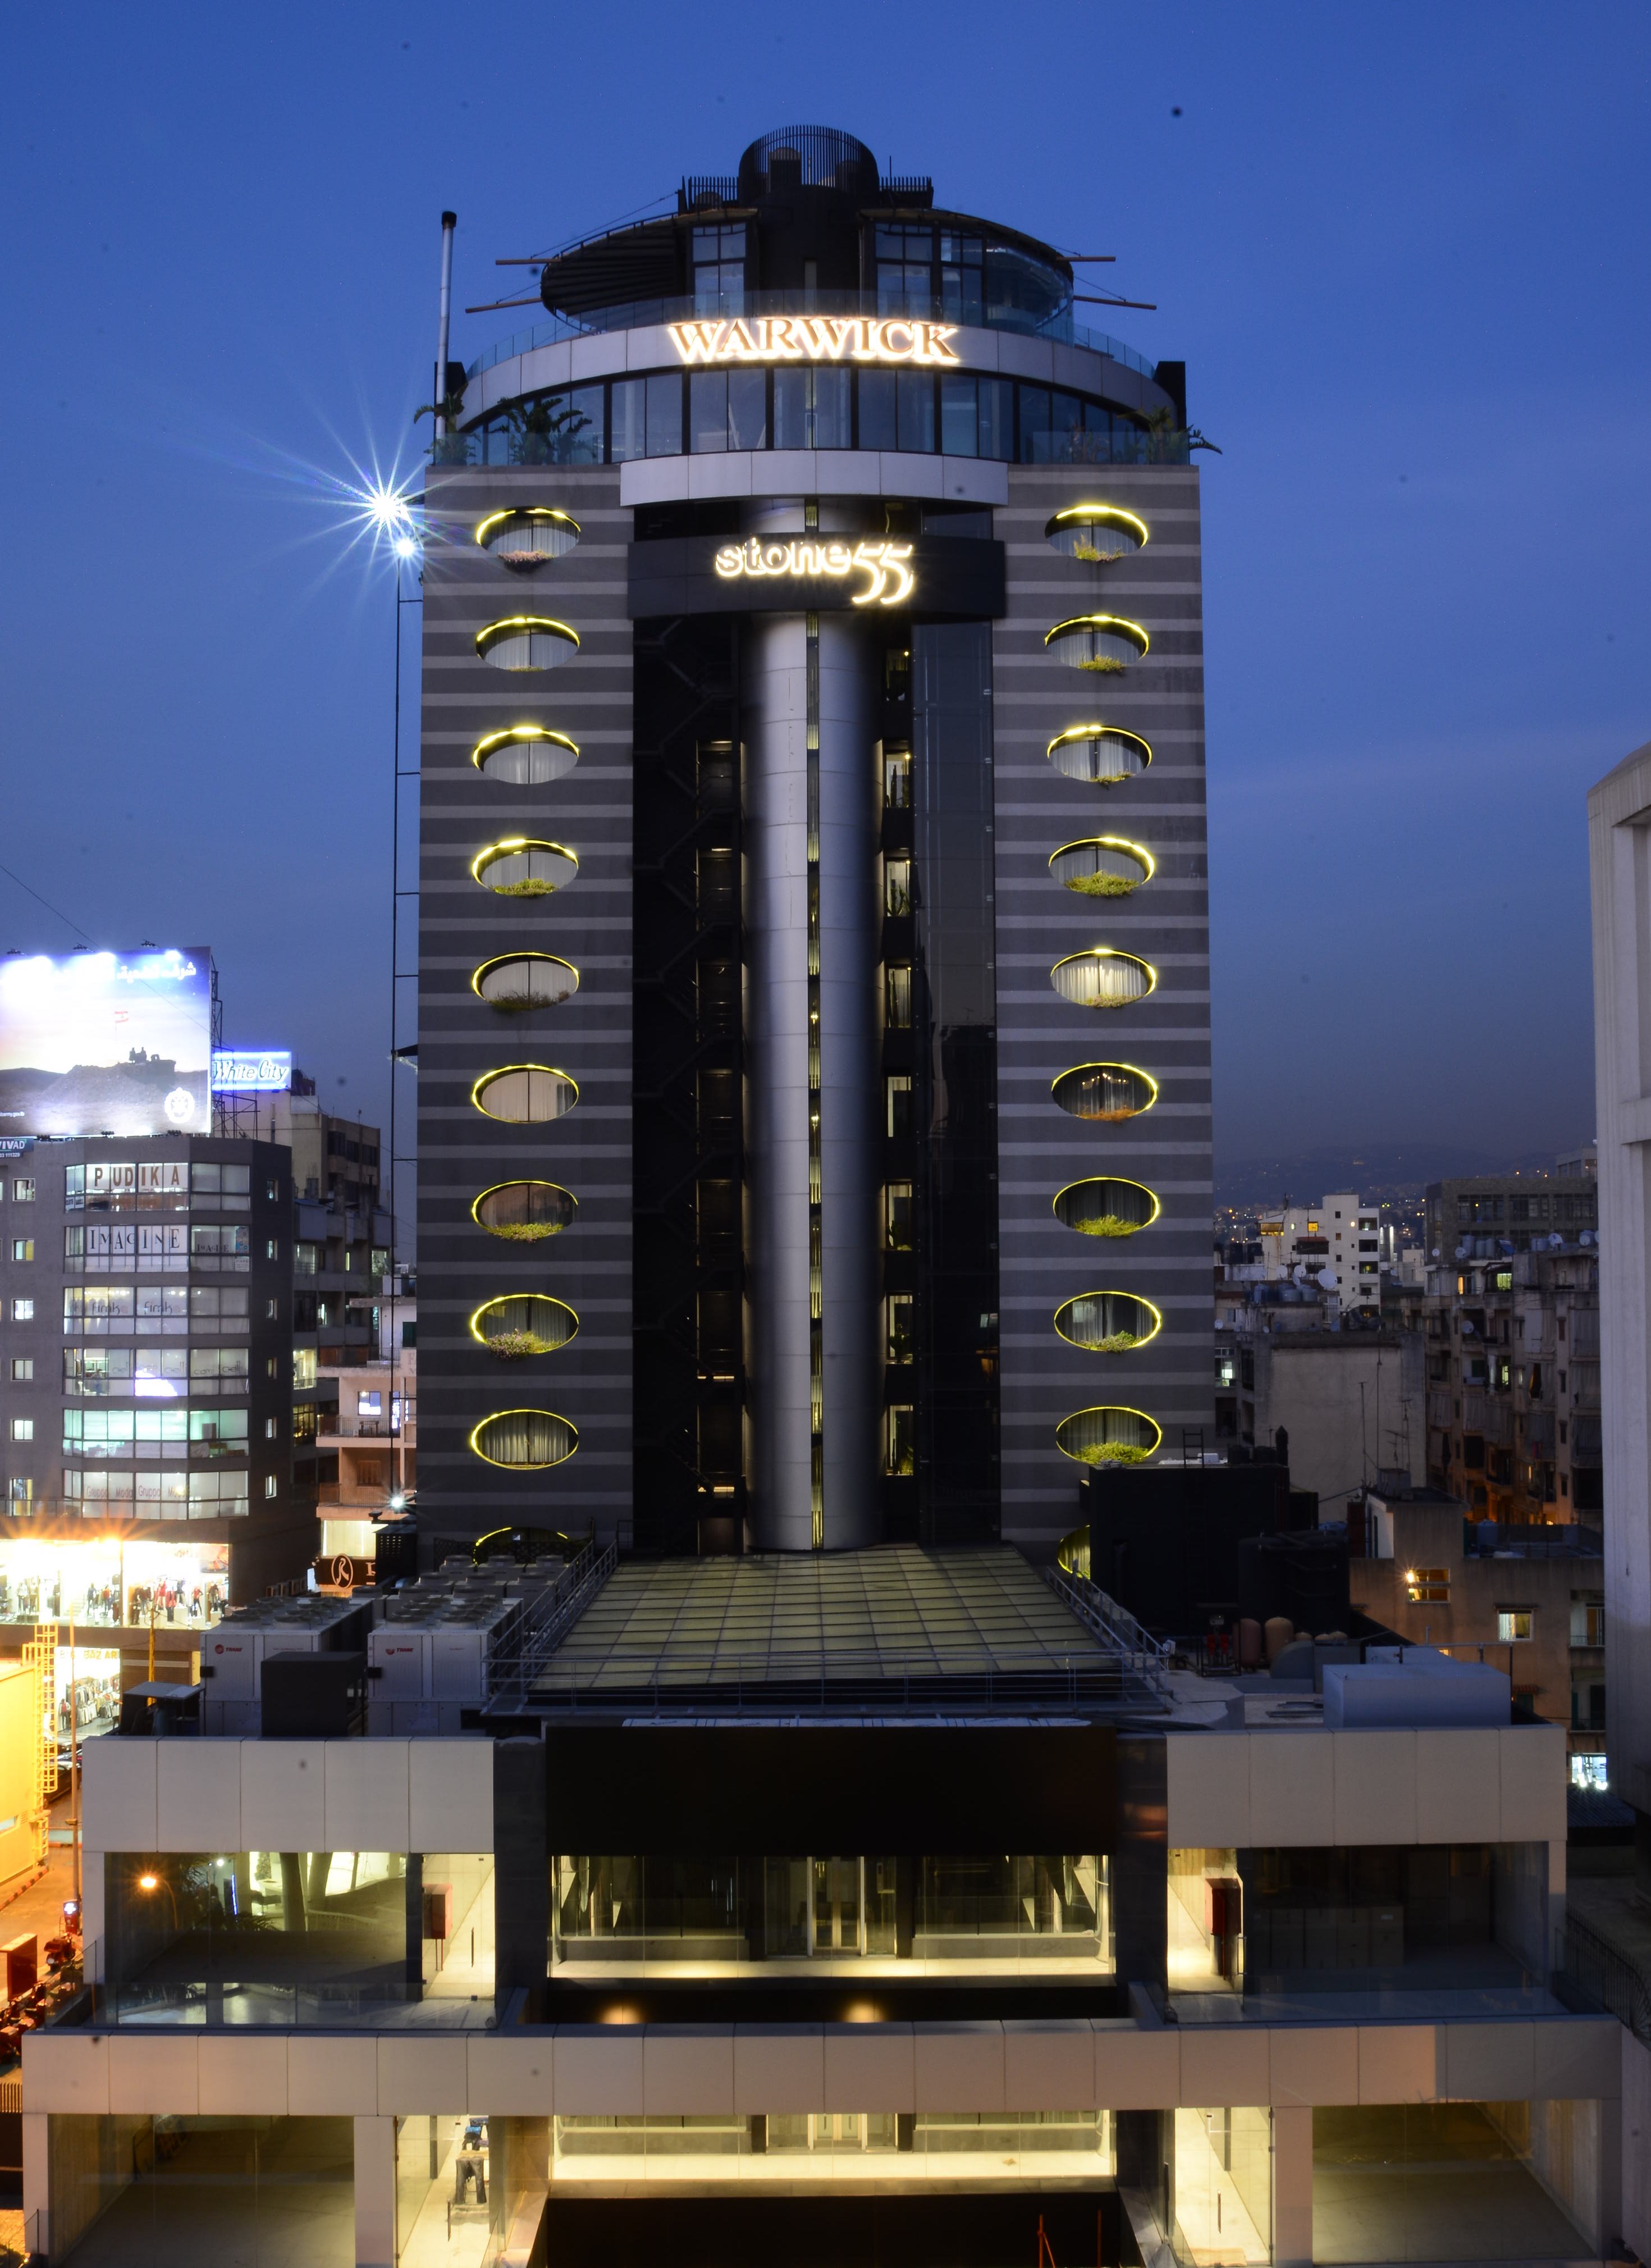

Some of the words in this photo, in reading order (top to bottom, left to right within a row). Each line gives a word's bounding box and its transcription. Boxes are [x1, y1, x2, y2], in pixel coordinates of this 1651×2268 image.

[668, 317, 959, 363] WARWICK
[213, 1060, 255, 1079] White
[259, 1060, 287, 1081] City
[94, 1166, 180, 1187] PUDIKA
